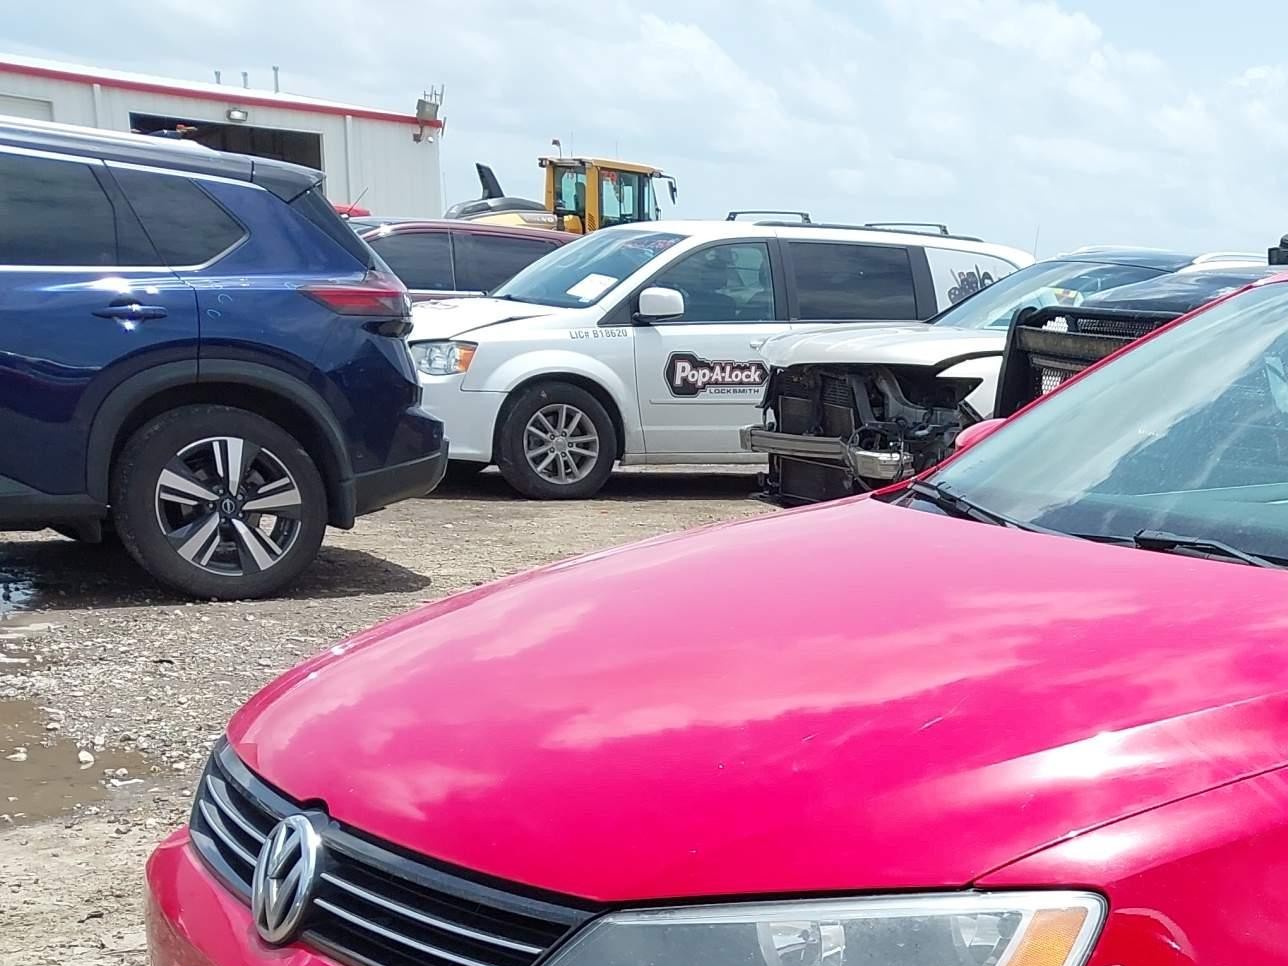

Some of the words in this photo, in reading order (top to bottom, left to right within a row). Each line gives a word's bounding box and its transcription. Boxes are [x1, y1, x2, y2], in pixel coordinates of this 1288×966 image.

[569, 329, 590, 340] LIC#
[592, 328, 628, 338] B18620
[709, 387, 760, 395] LOCKSMITH
